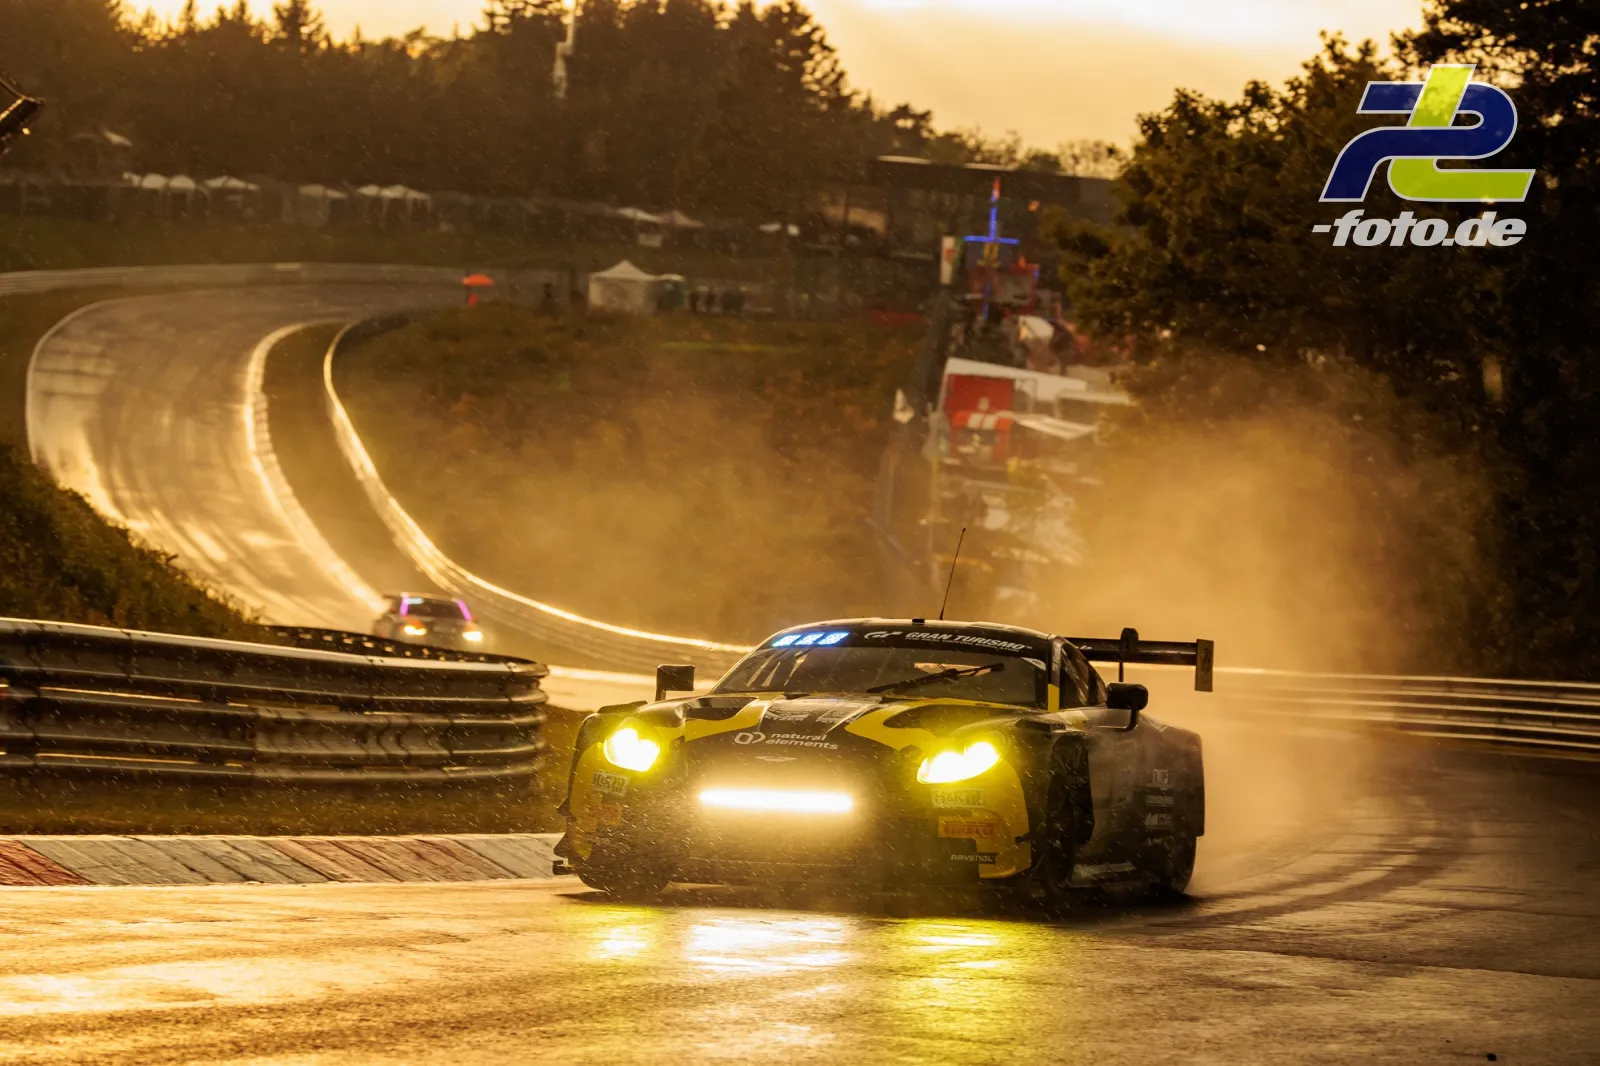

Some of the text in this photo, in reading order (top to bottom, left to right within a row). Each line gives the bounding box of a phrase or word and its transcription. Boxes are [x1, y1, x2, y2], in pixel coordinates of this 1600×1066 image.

[905, 632, 953, 640] GRAN
[954, 635, 1026, 650] TURISMO
[770, 732, 828, 741] natural
[765, 738, 839, 750] elements
[950, 854, 993, 862] RAVENOL
